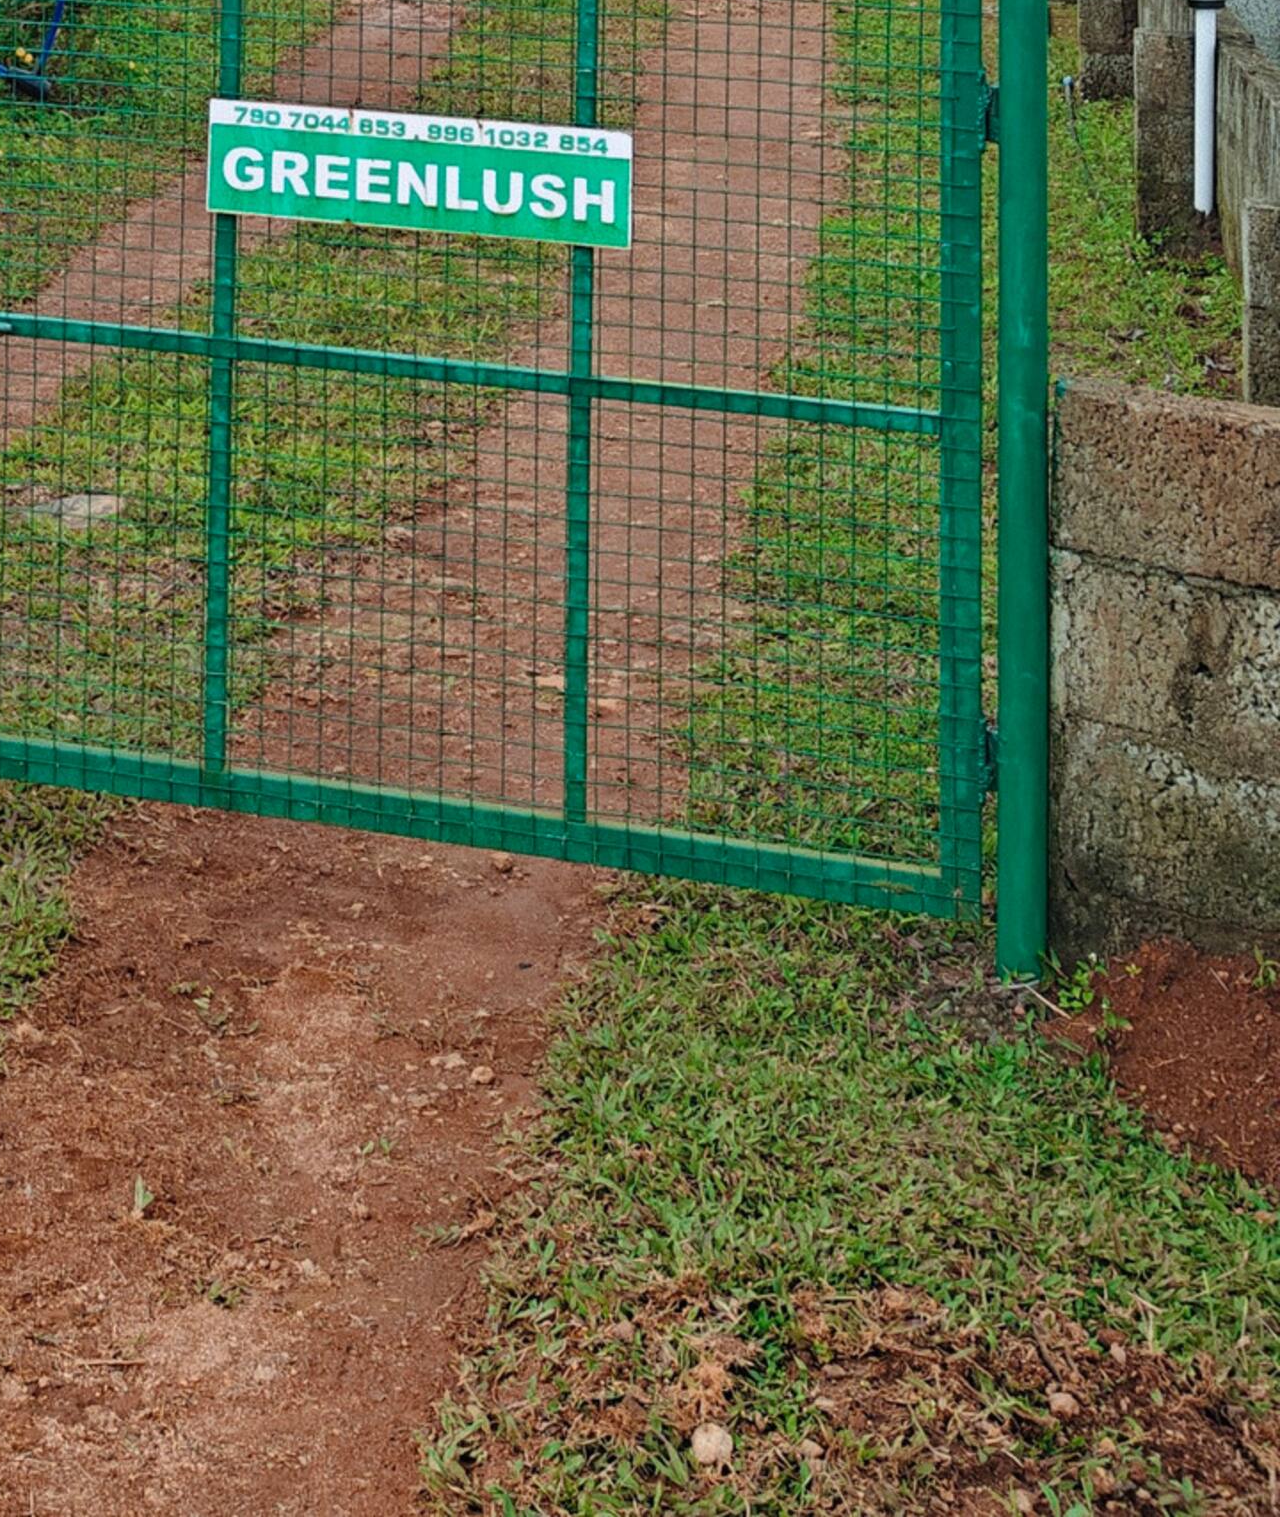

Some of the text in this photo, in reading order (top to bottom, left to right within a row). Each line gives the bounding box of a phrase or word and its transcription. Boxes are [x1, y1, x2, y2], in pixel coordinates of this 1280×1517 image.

[234, 106, 281, 125] 790
[288, 112, 351, 132] 7044
[427, 124, 474, 142] 996
[485, 129, 548, 147] 1032
[559, 135, 608, 154] 854
[222, 146, 615, 224] GREENLUSH
